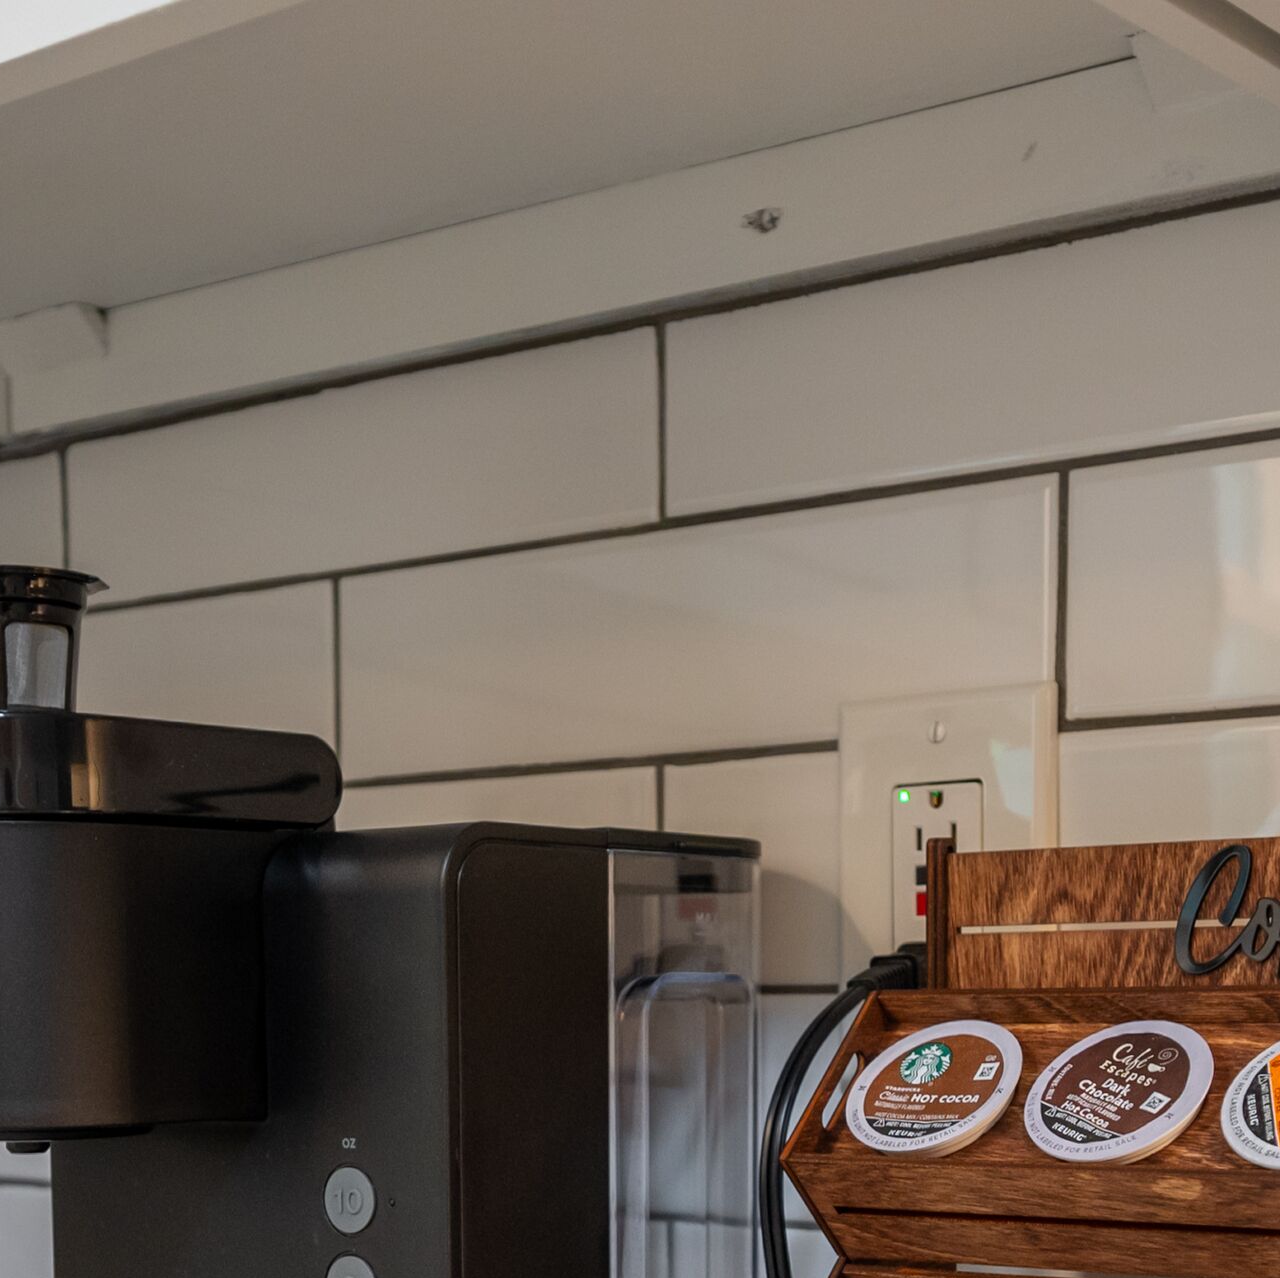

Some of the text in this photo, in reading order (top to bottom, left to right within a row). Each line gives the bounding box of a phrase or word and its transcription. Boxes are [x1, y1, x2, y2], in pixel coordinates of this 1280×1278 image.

[1112, 1043, 1155, 1071] Café
[1099, 1060, 1153, 1087] Escapes
[1102, 1078, 1131, 1096] Dark
[910, 1093, 938, 1103] HOT
[939, 1094, 980, 1104] COCOA
[1079, 1079, 1134, 1110] Chocolate
[1060, 1100, 1080, 1113] Hot
[1080, 1108, 1109, 1128] Cocoa
[1246, 1093, 1259, 1126] KEURIG
[342, 1137, 357, 1149] OZ
[1052, 1122, 1083, 1141] KEURIG
[334, 1187, 364, 1215] 10
